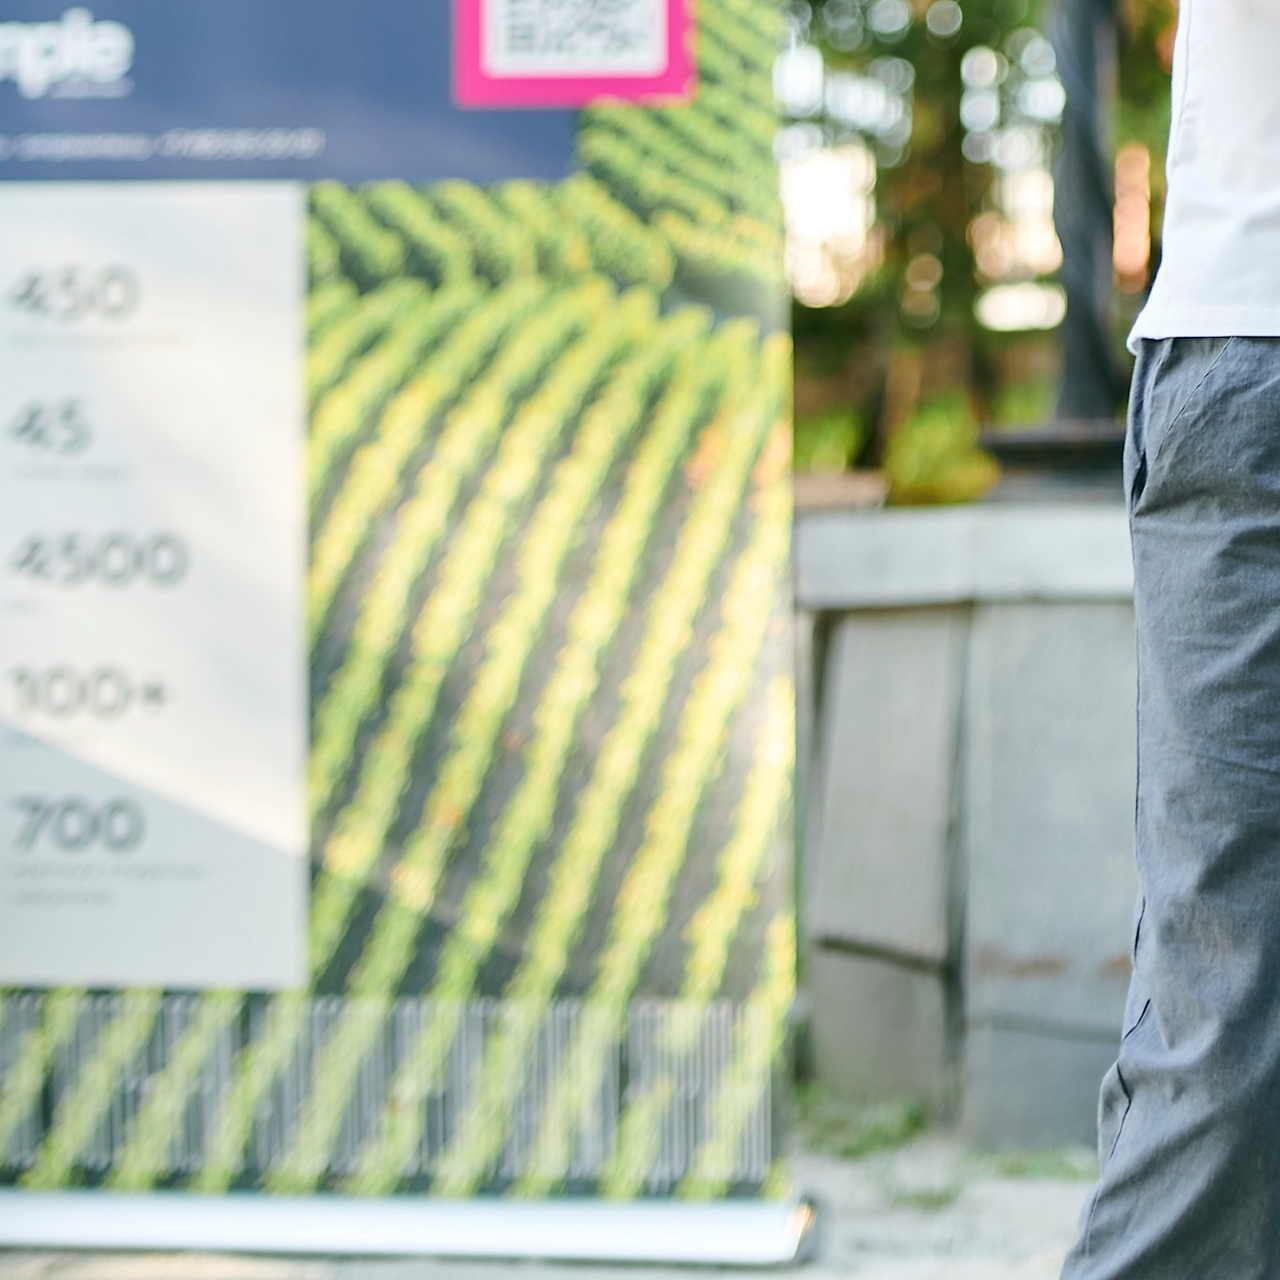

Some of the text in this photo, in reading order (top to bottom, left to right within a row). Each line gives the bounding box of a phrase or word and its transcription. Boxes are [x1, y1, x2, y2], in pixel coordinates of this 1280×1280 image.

[8, 264, 140, 321] 450
[8, 398, 93, 456] 45
[8, 531, 190, 587] 4500
[8, 663, 168, 719] 100+
[7, 796, 146, 853] 700
